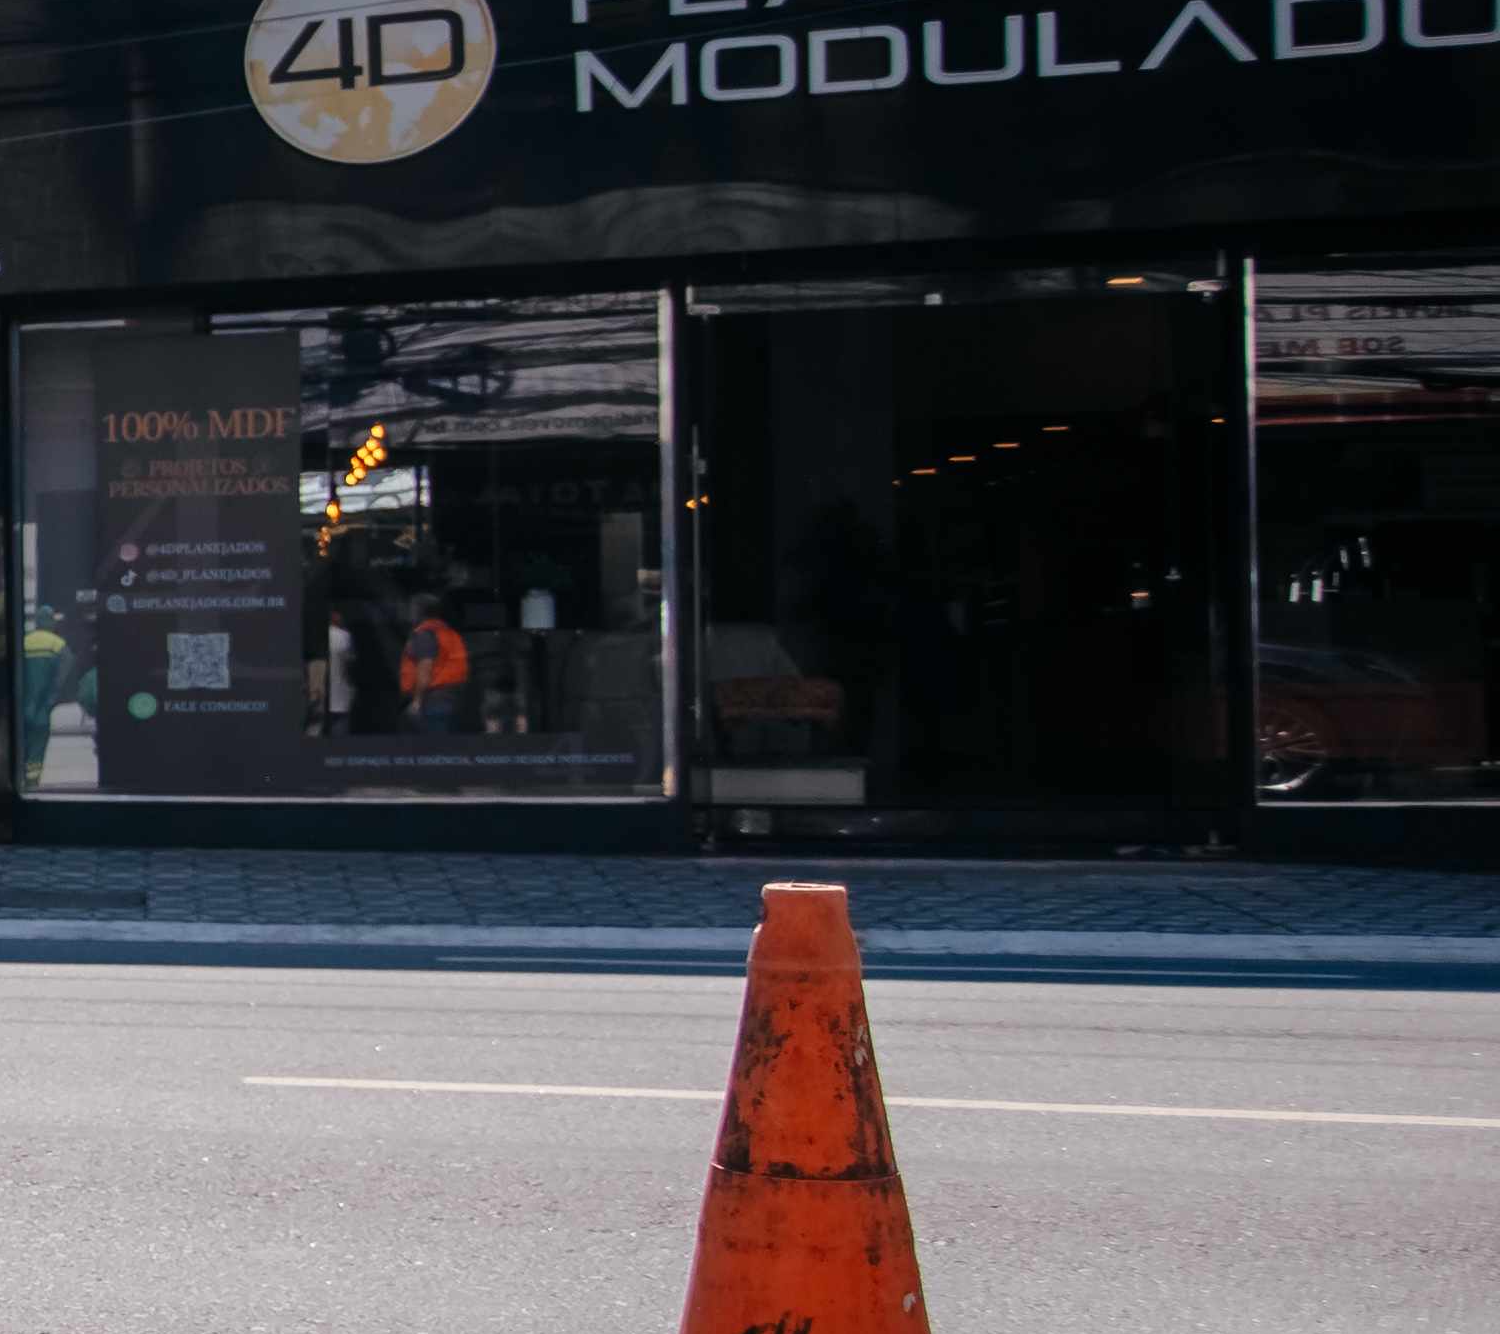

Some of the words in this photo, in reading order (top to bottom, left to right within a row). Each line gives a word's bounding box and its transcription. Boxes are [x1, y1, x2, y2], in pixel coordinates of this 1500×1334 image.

[269, 8, 466, 91] 4D
[103, 409, 199, 443] 100%
[207, 406, 297, 439] MDF
